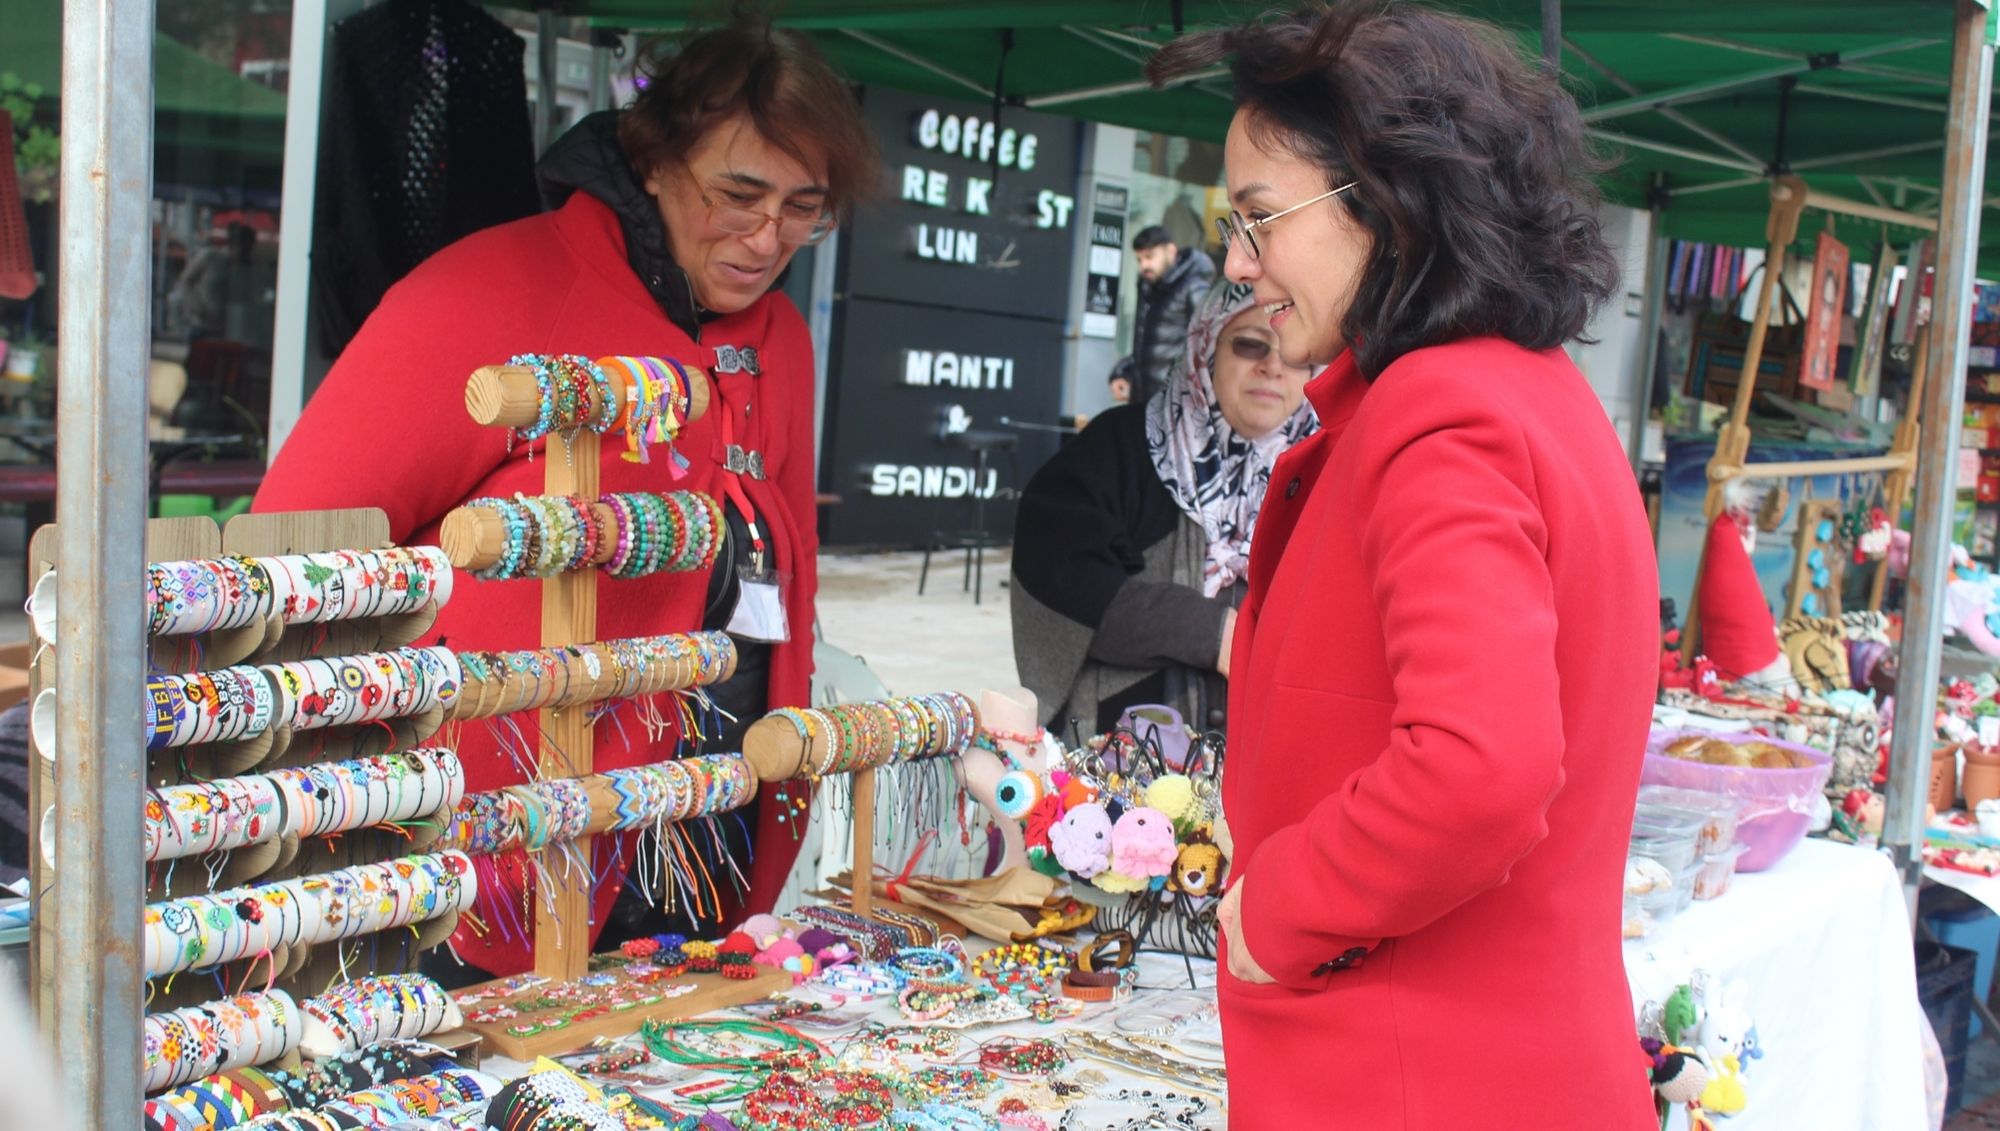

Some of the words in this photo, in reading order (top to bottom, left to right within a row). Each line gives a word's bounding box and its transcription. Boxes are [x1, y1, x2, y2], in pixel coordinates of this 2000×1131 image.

[919, 109, 1038, 171] COFFEE
[918, 223, 977, 263] LUN
[905, 350, 1014, 389] MANTI
[947, 404, 972, 433] &
